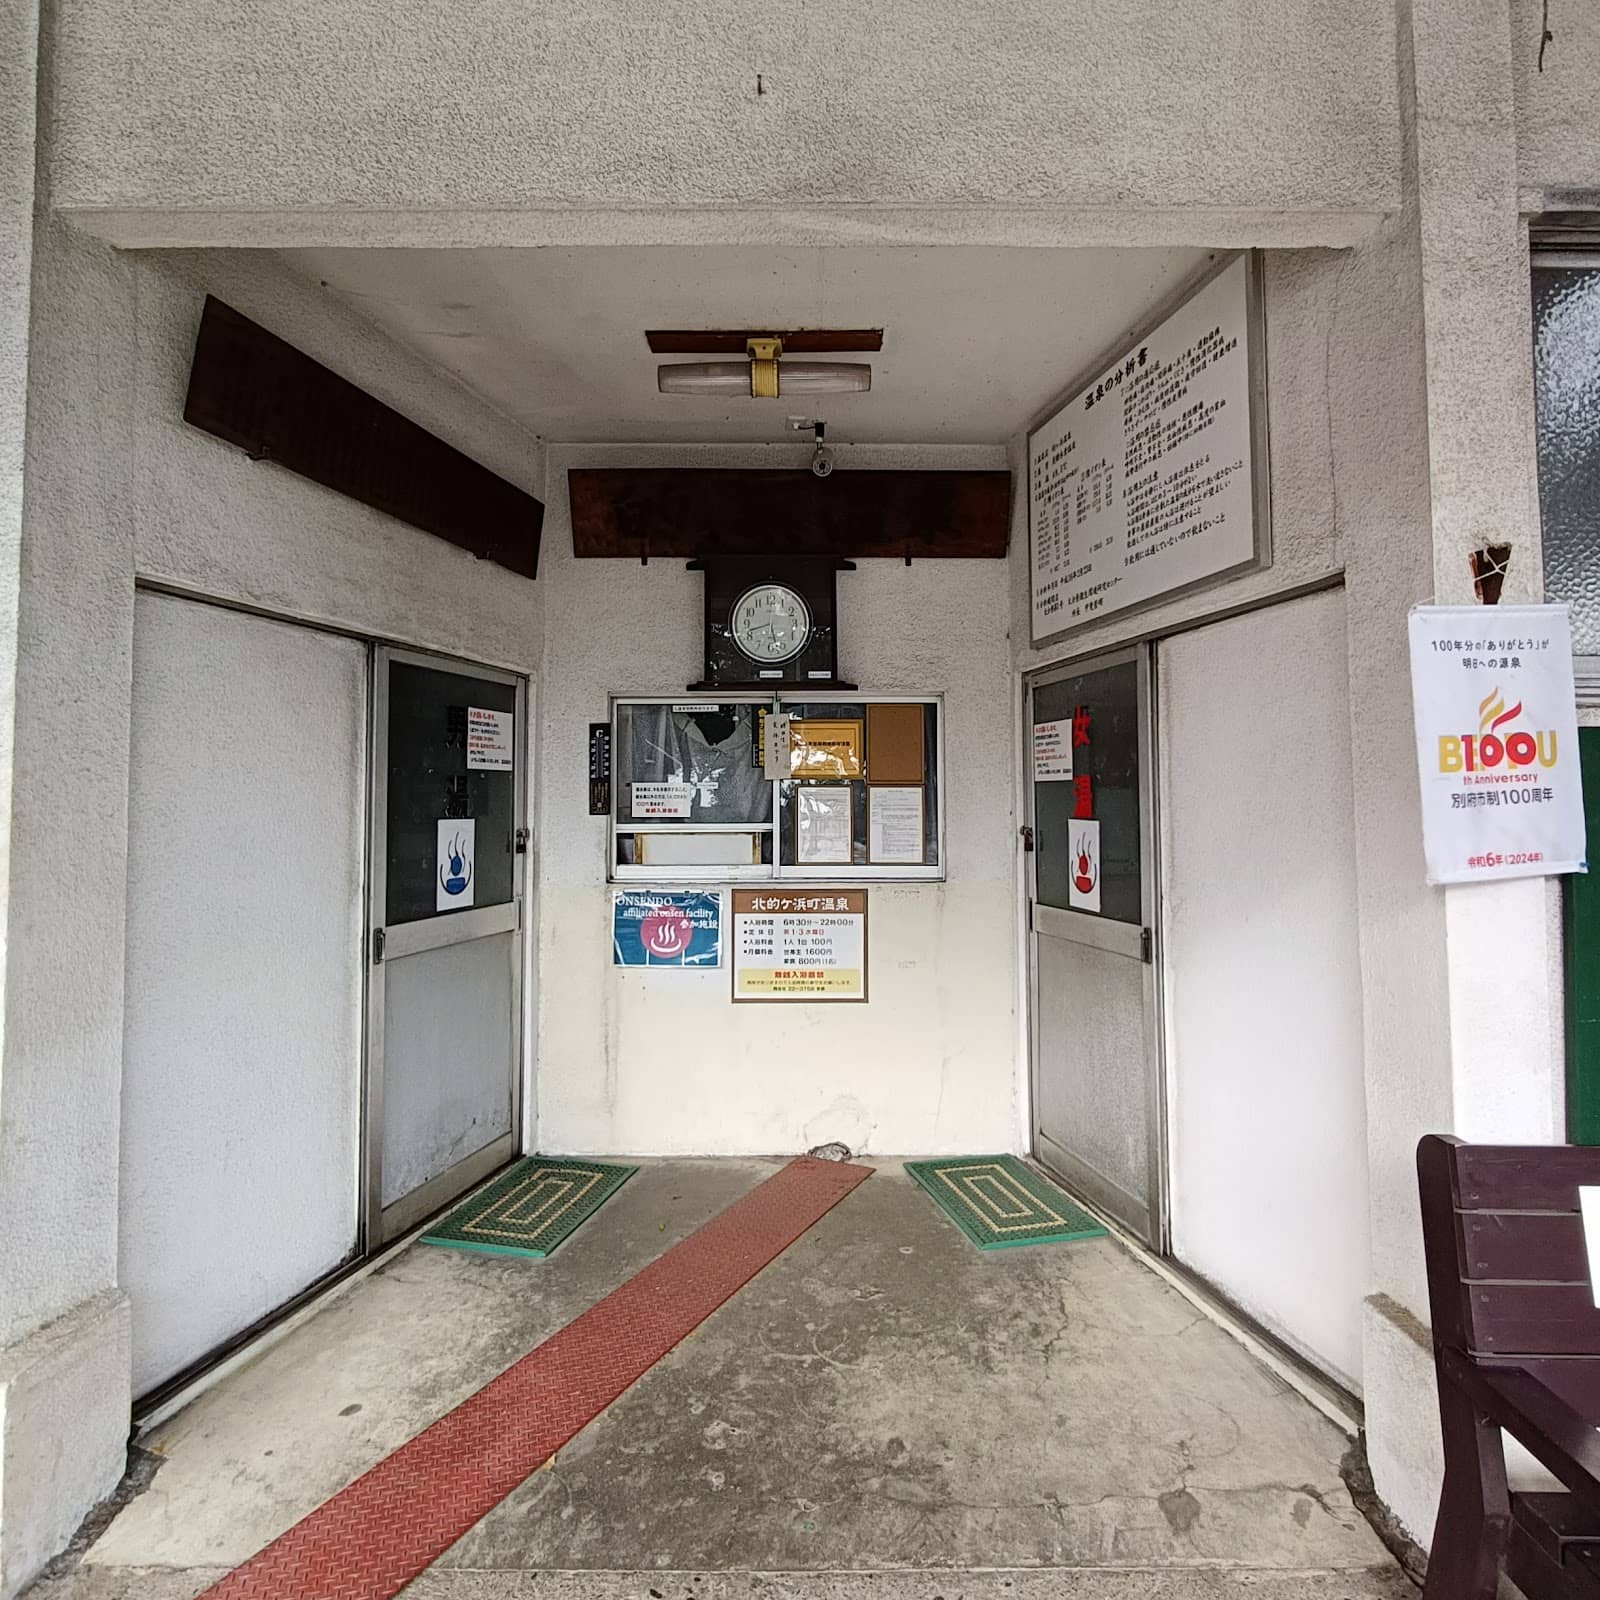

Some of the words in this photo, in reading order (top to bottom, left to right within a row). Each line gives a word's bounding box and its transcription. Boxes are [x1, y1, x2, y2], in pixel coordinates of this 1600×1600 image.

[1085, 347, 1148, 410] 温泉の分析書
[1432, 638, 1549, 651] 100年分の「ありがとう」が
[1462, 656, 1521, 669] 明日への源泉
[1474, 773, 1539, 785] Anniversary
[1451, 787, 1554, 808] 別府市制100周年
[616, 896, 673, 906] ONSENDO
[623, 907, 658, 919] affiliated
[685, 907, 714, 919] facility
